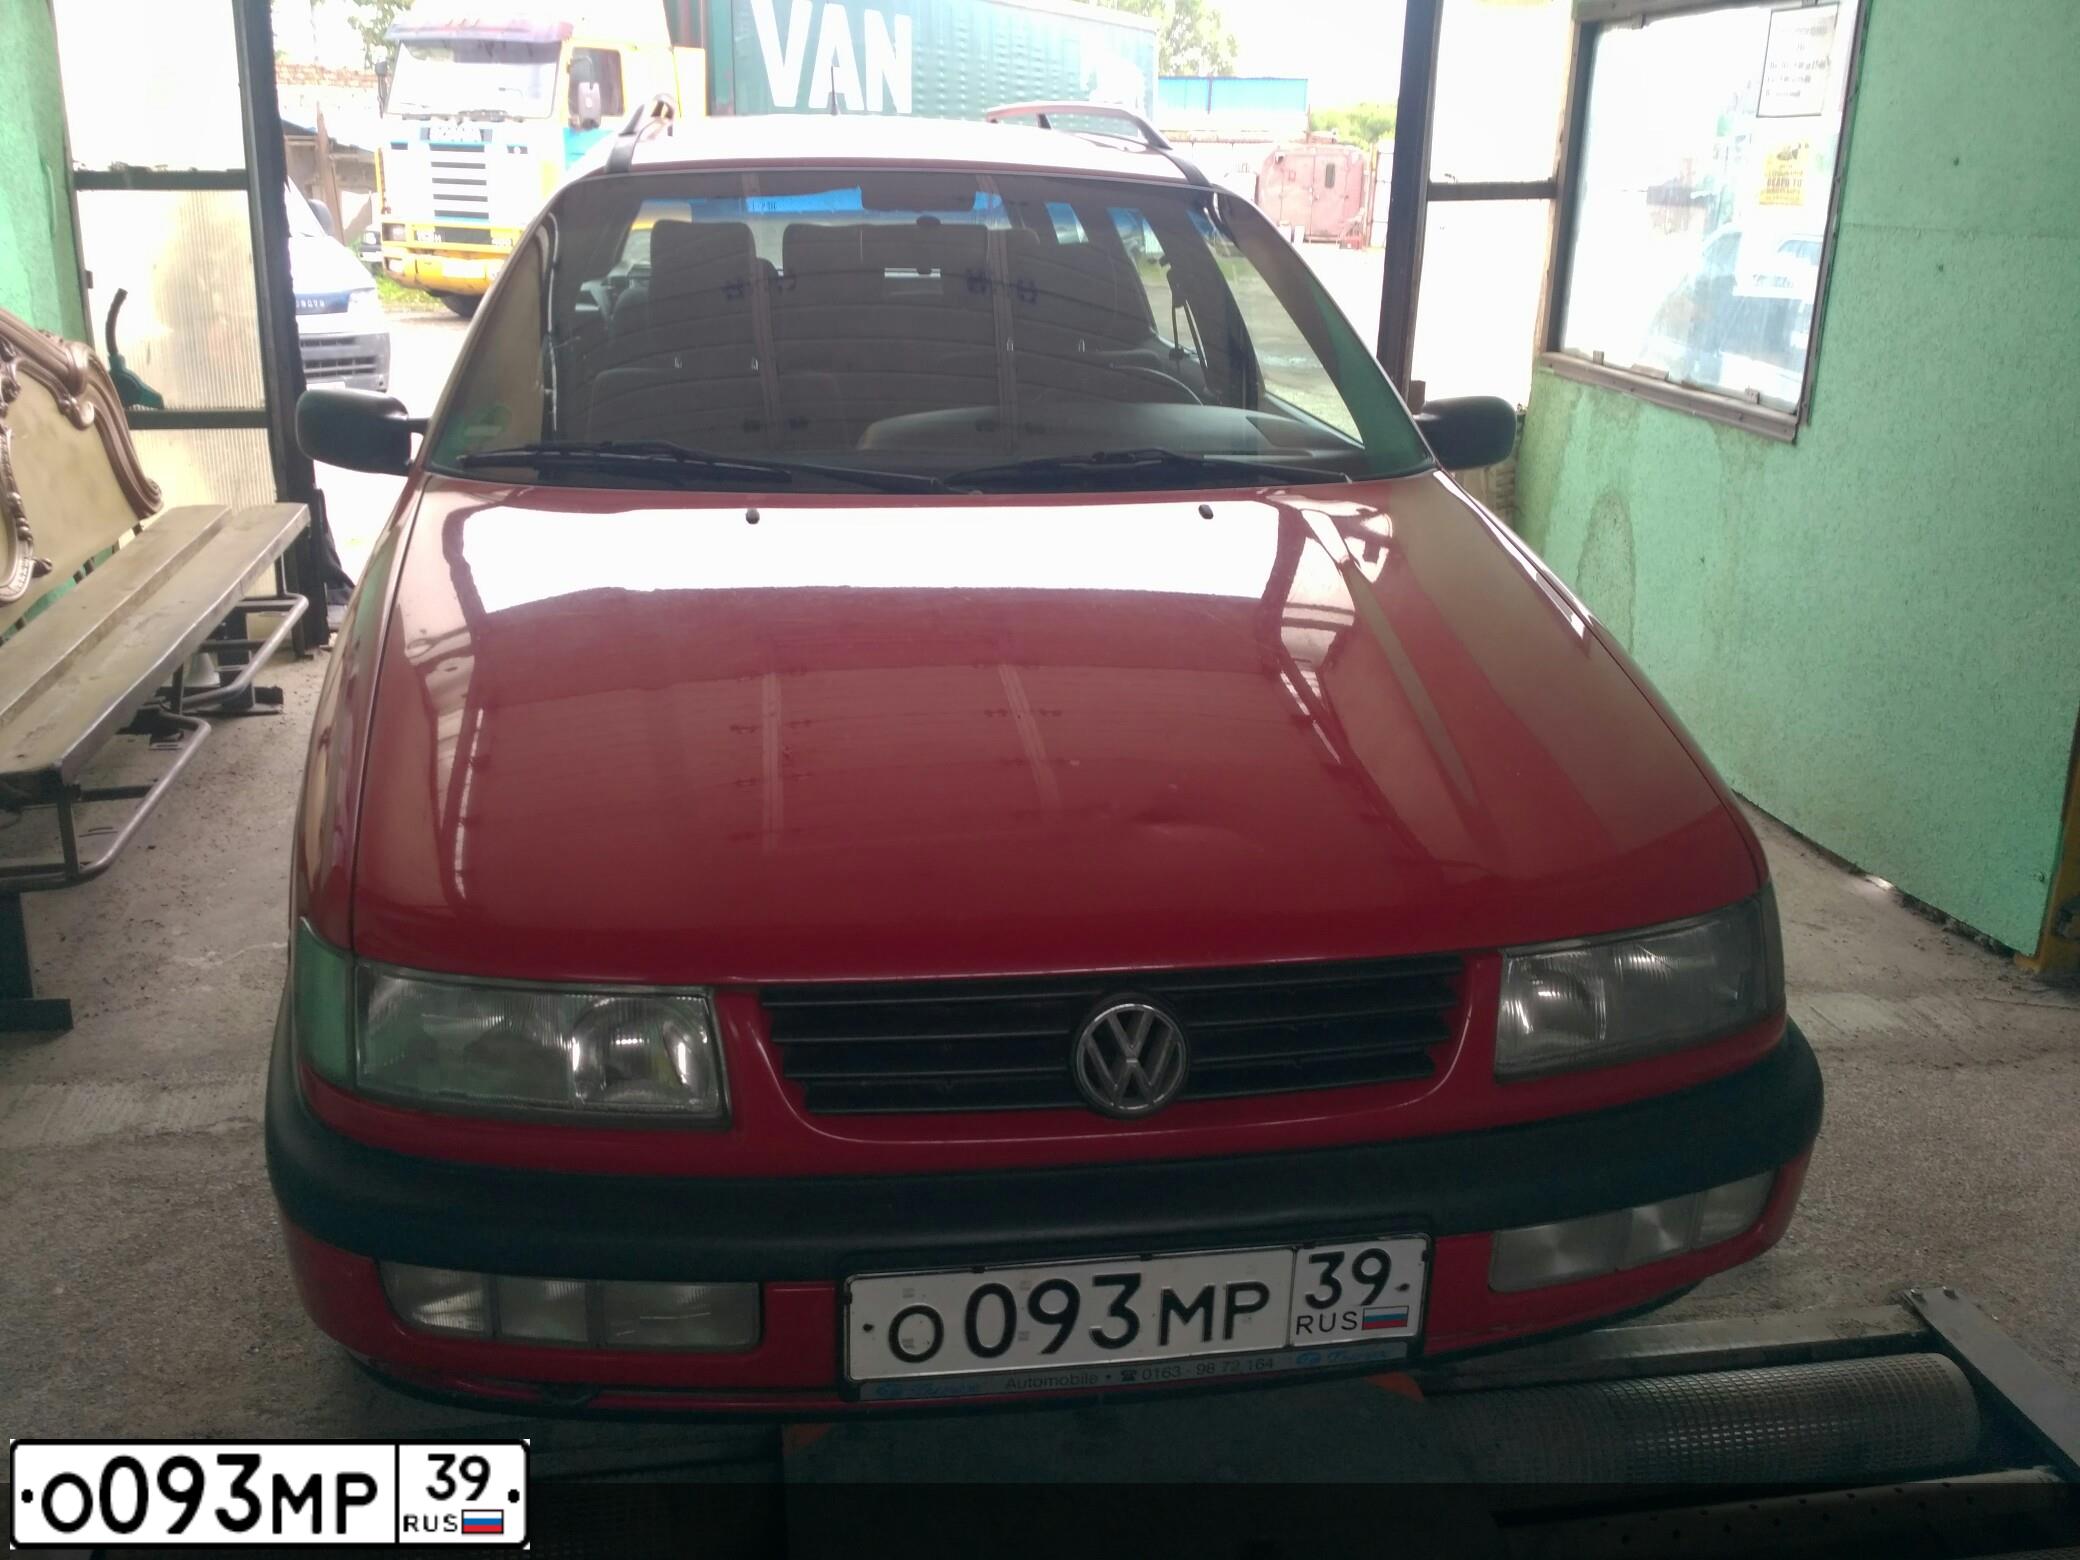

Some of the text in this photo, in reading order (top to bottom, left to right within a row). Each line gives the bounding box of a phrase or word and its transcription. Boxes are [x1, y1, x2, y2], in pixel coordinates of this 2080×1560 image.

[750, 0, 912, 114] VAN
[1304, 1247, 1392, 1310] 39
[1296, 1305, 1358, 1336] RUS
[1004, 1373, 1098, 1391] Automobile
